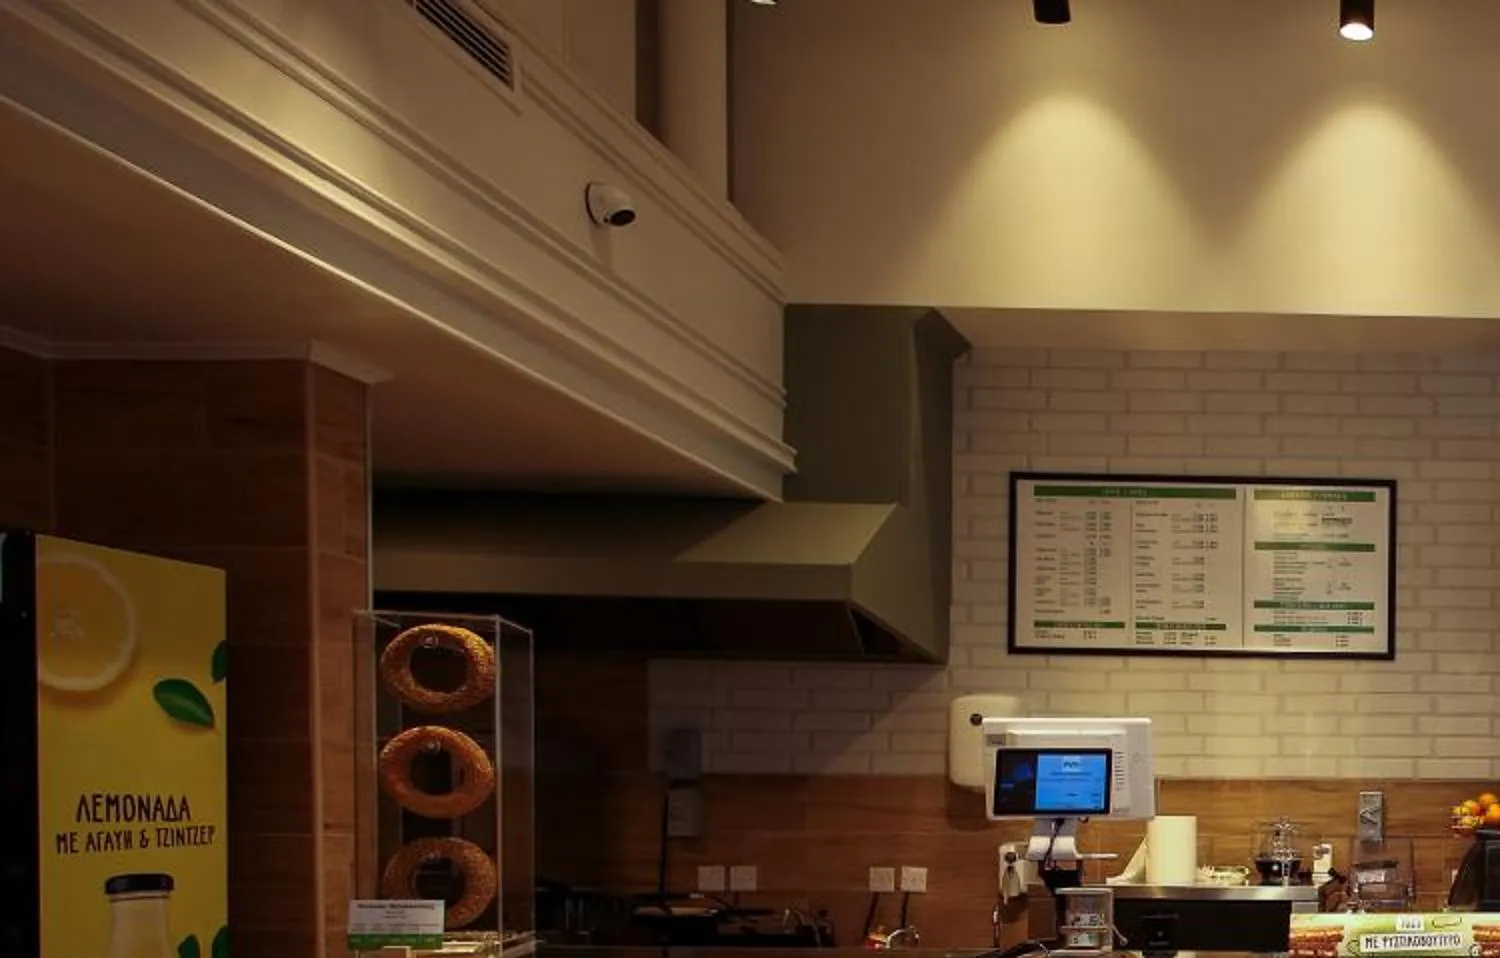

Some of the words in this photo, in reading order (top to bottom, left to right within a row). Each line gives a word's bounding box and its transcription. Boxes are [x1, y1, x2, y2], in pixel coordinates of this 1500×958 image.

[76, 794, 191, 823] ΛΕΜΟΝΑΔΑ
[56, 832, 79, 855] ΜΕ
[140, 829, 149, 849] &
